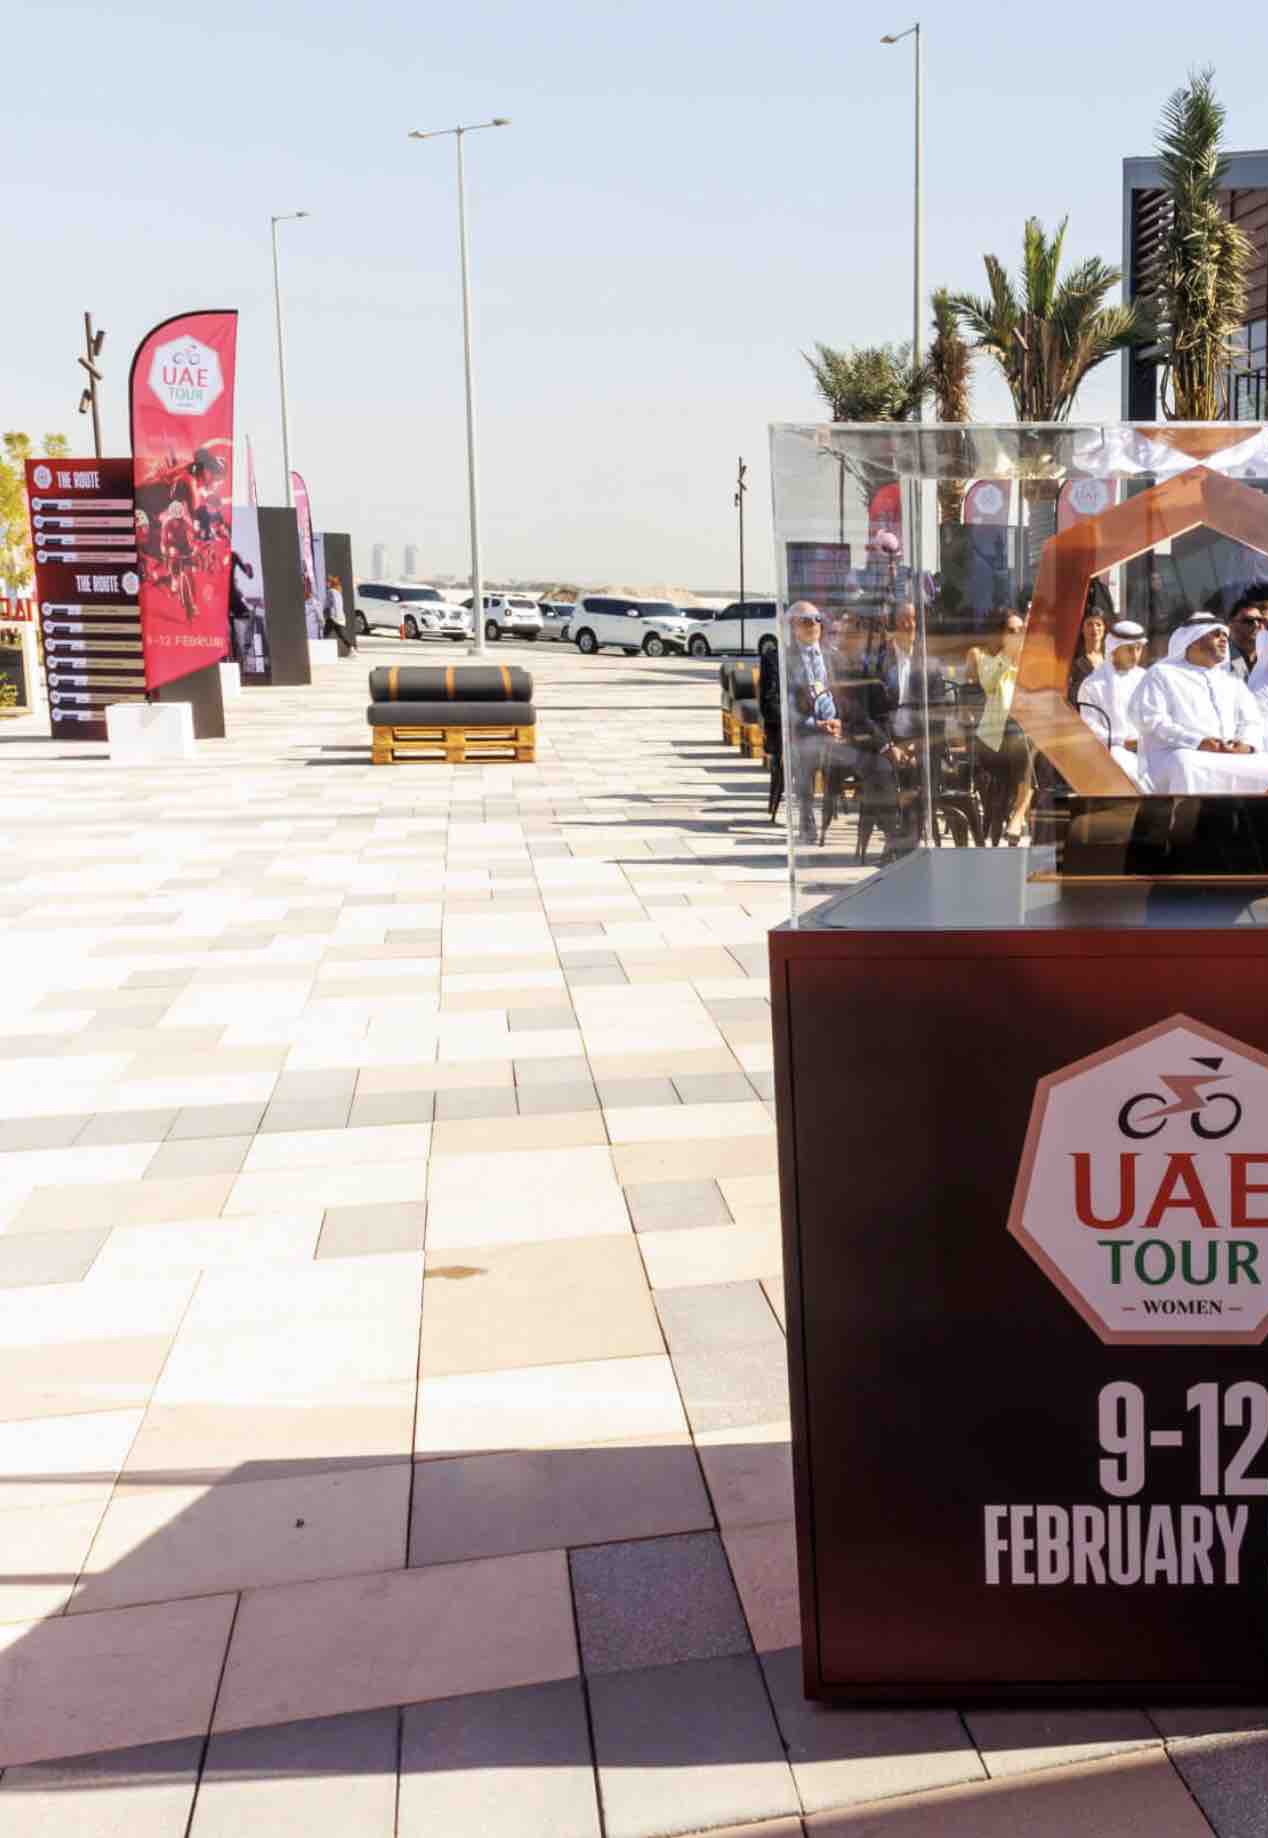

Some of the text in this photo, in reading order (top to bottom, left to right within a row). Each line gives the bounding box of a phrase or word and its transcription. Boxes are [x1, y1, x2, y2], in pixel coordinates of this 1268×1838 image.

[162, 366, 209, 388] UAE
[56, 471, 72, 489] THE
[76, 575, 91, 592] THE
[1097, 1239, 1261, 1285] TOUR
[1143, 1299, 1223, 1315] WOMEN
[984, 1504, 1249, 1585] FEBRUARY
